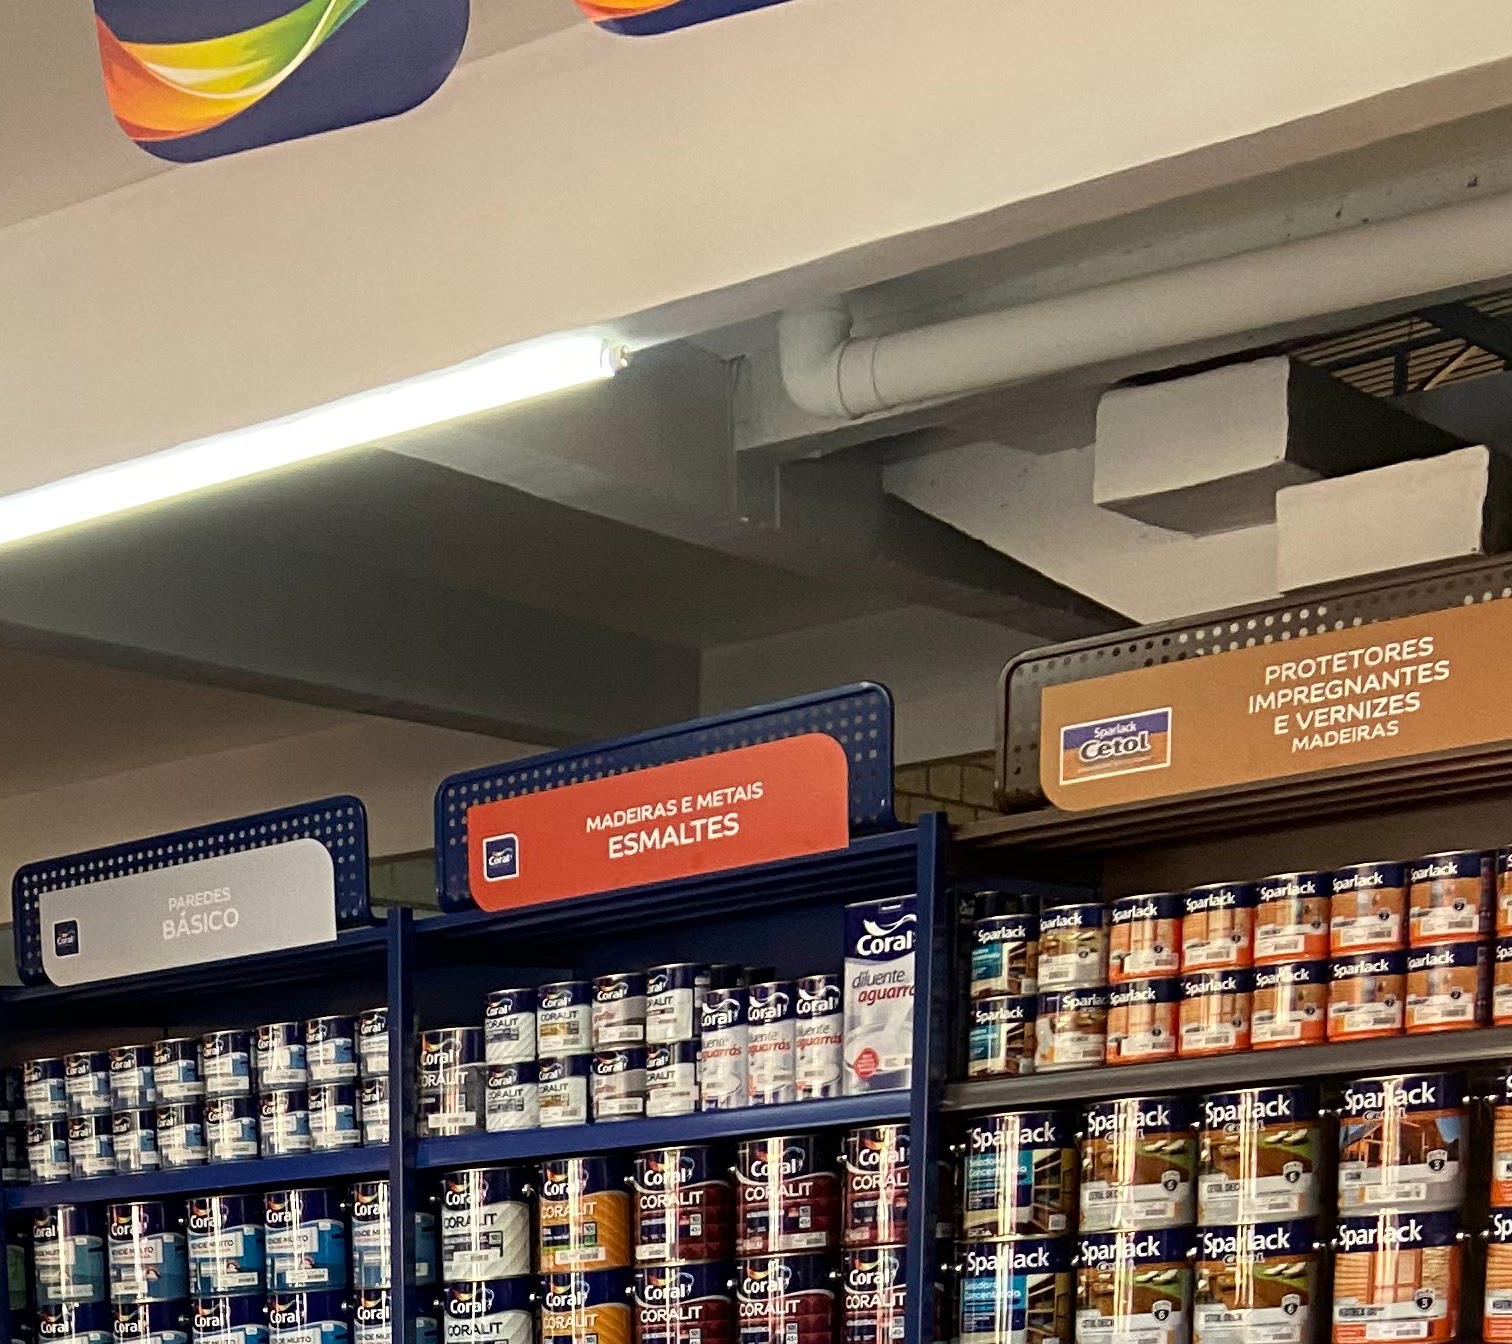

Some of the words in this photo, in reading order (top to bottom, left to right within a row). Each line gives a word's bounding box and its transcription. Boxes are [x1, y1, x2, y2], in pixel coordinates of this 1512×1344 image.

[1265, 636, 1434, 685] PROTETORES
[1248, 660, 1450, 715] IMPREGNANTES
[1274, 714, 1289, 735] E
[1296, 692, 1421, 731] VERNIZES
[1079, 731, 1152, 762] Cetol
[1291, 721, 1399, 753] MADEIRAS
[586, 798, 677, 833] MADEIRAS
[681, 796, 693, 813] E
[696, 781, 763, 811] METAIS
[608, 812, 739, 859] ESMALTES
[168, 887, 231, 911] PAREDES
[162, 908, 239, 940] BÁSICO
[978, 925, 1026, 943] Sparlack
[857, 931, 913, 957] Coral
[852, 969, 905, 989] diluente
[1334, 959, 1389, 978] Sparlack
